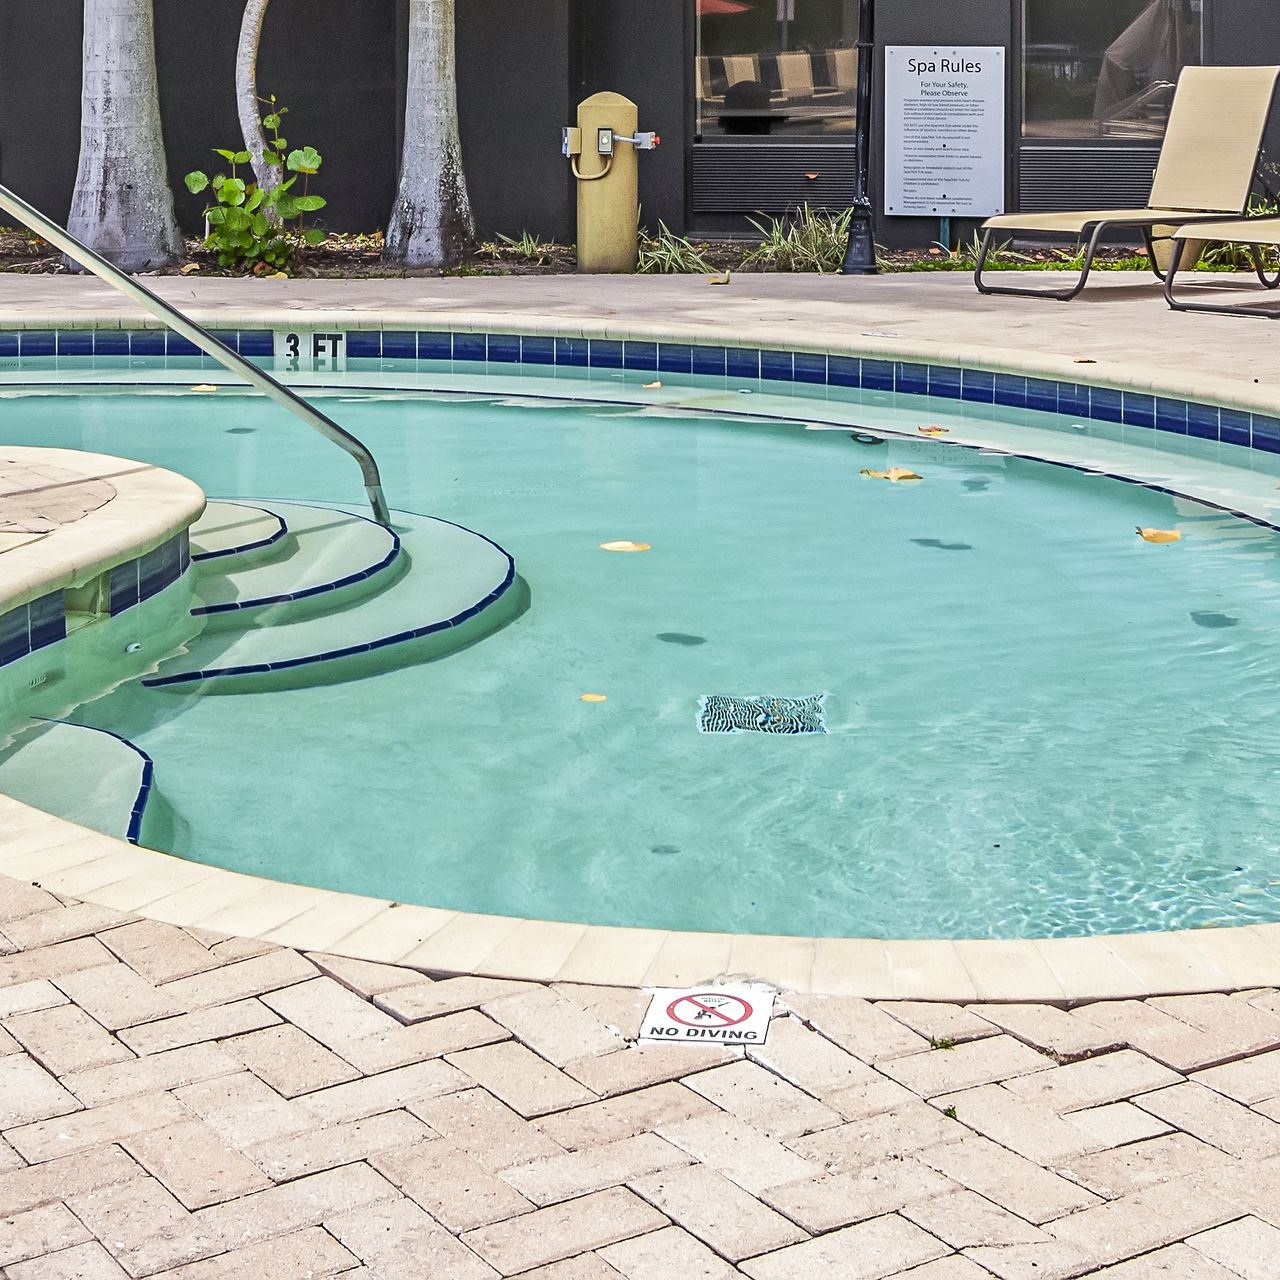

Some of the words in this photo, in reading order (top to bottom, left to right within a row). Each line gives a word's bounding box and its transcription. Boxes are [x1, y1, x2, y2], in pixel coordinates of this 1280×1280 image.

[907, 58, 936, 76] Spa
[941, 58, 982, 73] Rules
[286, 333, 300, 357] 3
[313, 333, 343, 357] FT
[650, 1026, 679, 1036] NO
[686, 1028, 758, 1040] DIVING
